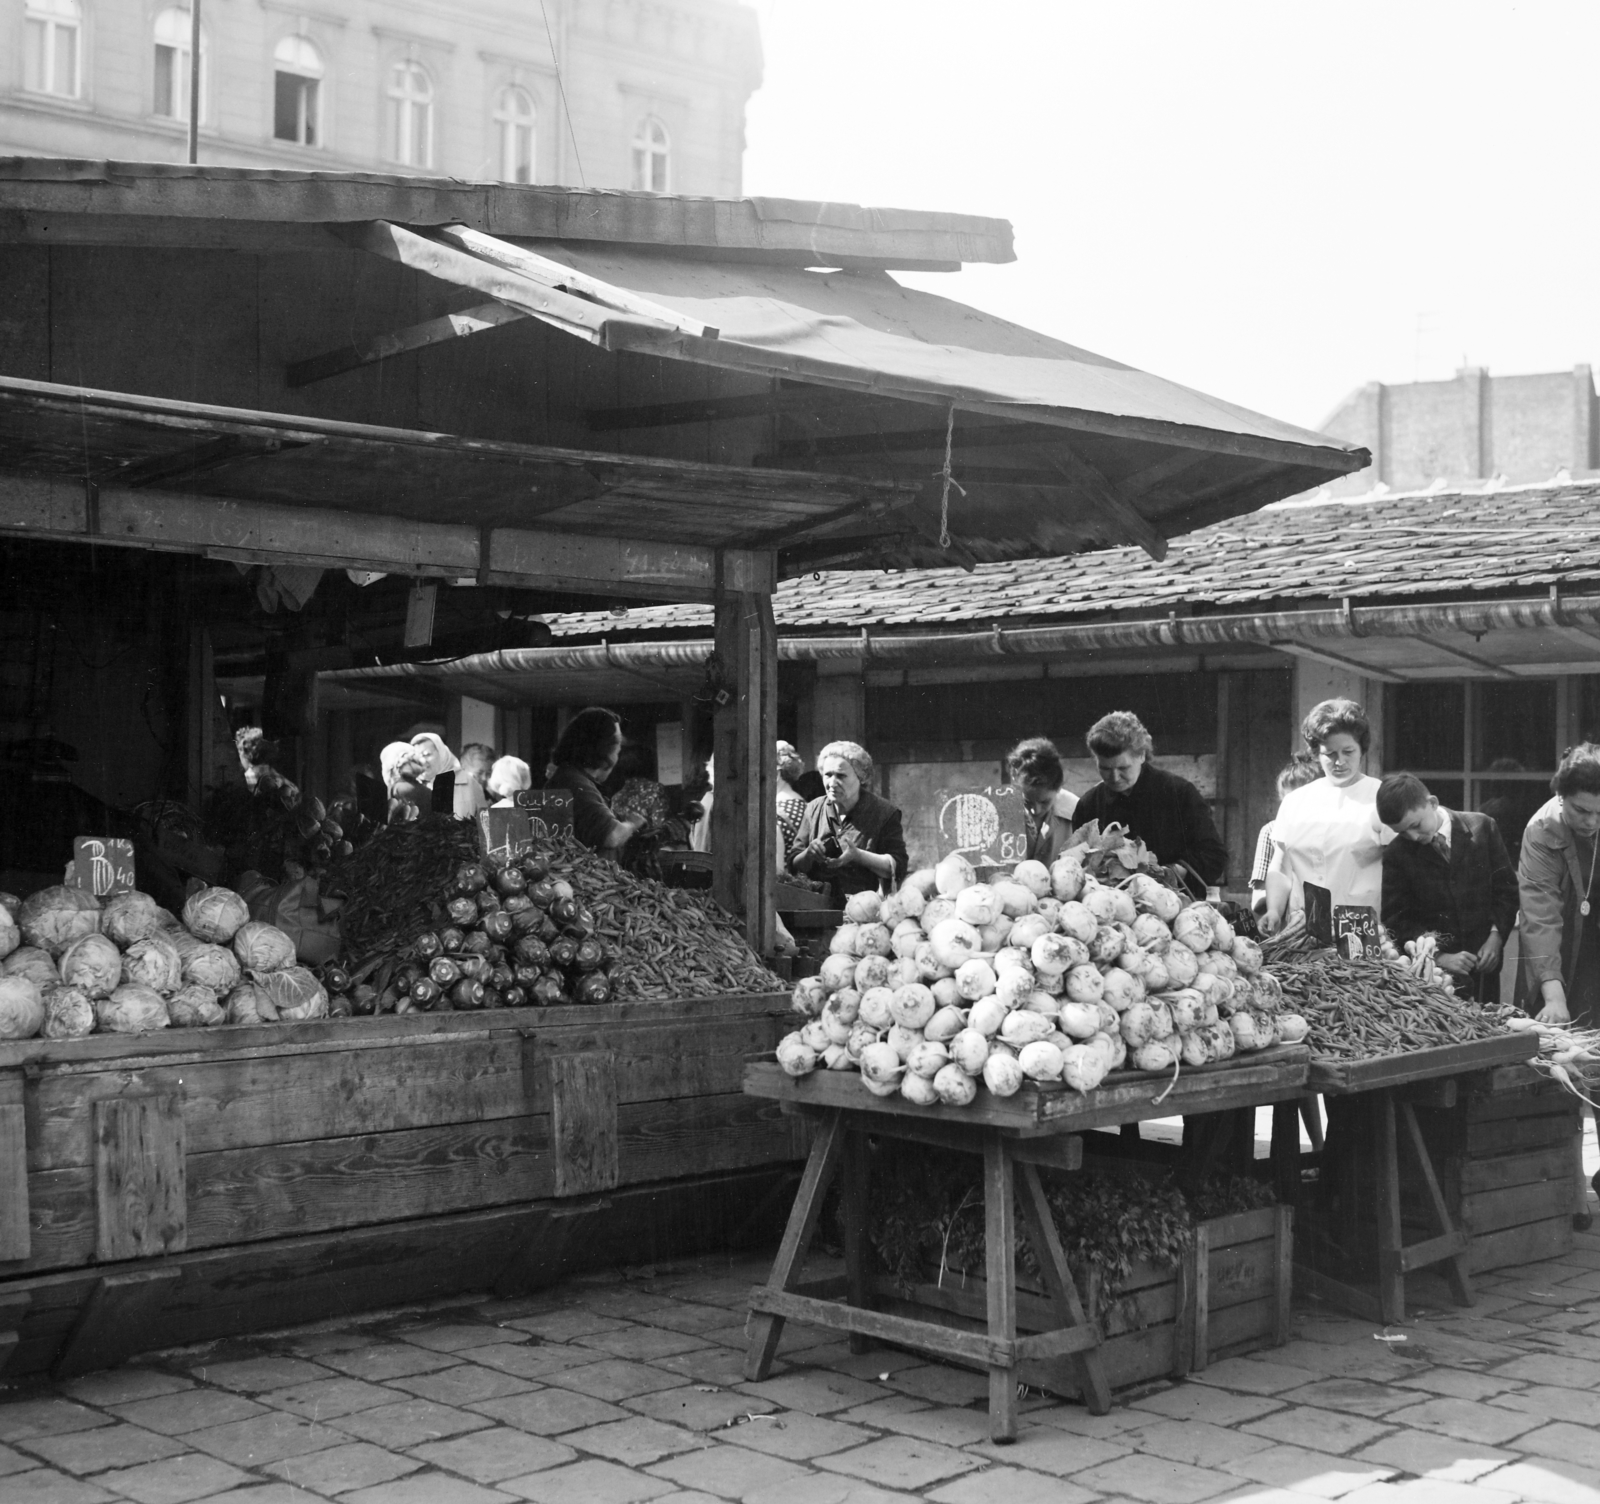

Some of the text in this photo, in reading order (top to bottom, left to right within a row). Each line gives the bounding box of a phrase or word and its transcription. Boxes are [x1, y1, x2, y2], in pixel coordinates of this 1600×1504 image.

[1000, 832, 1027, 859] 80
[116, 866, 135, 887] 40
[1365, 944, 1382, 958] 60
